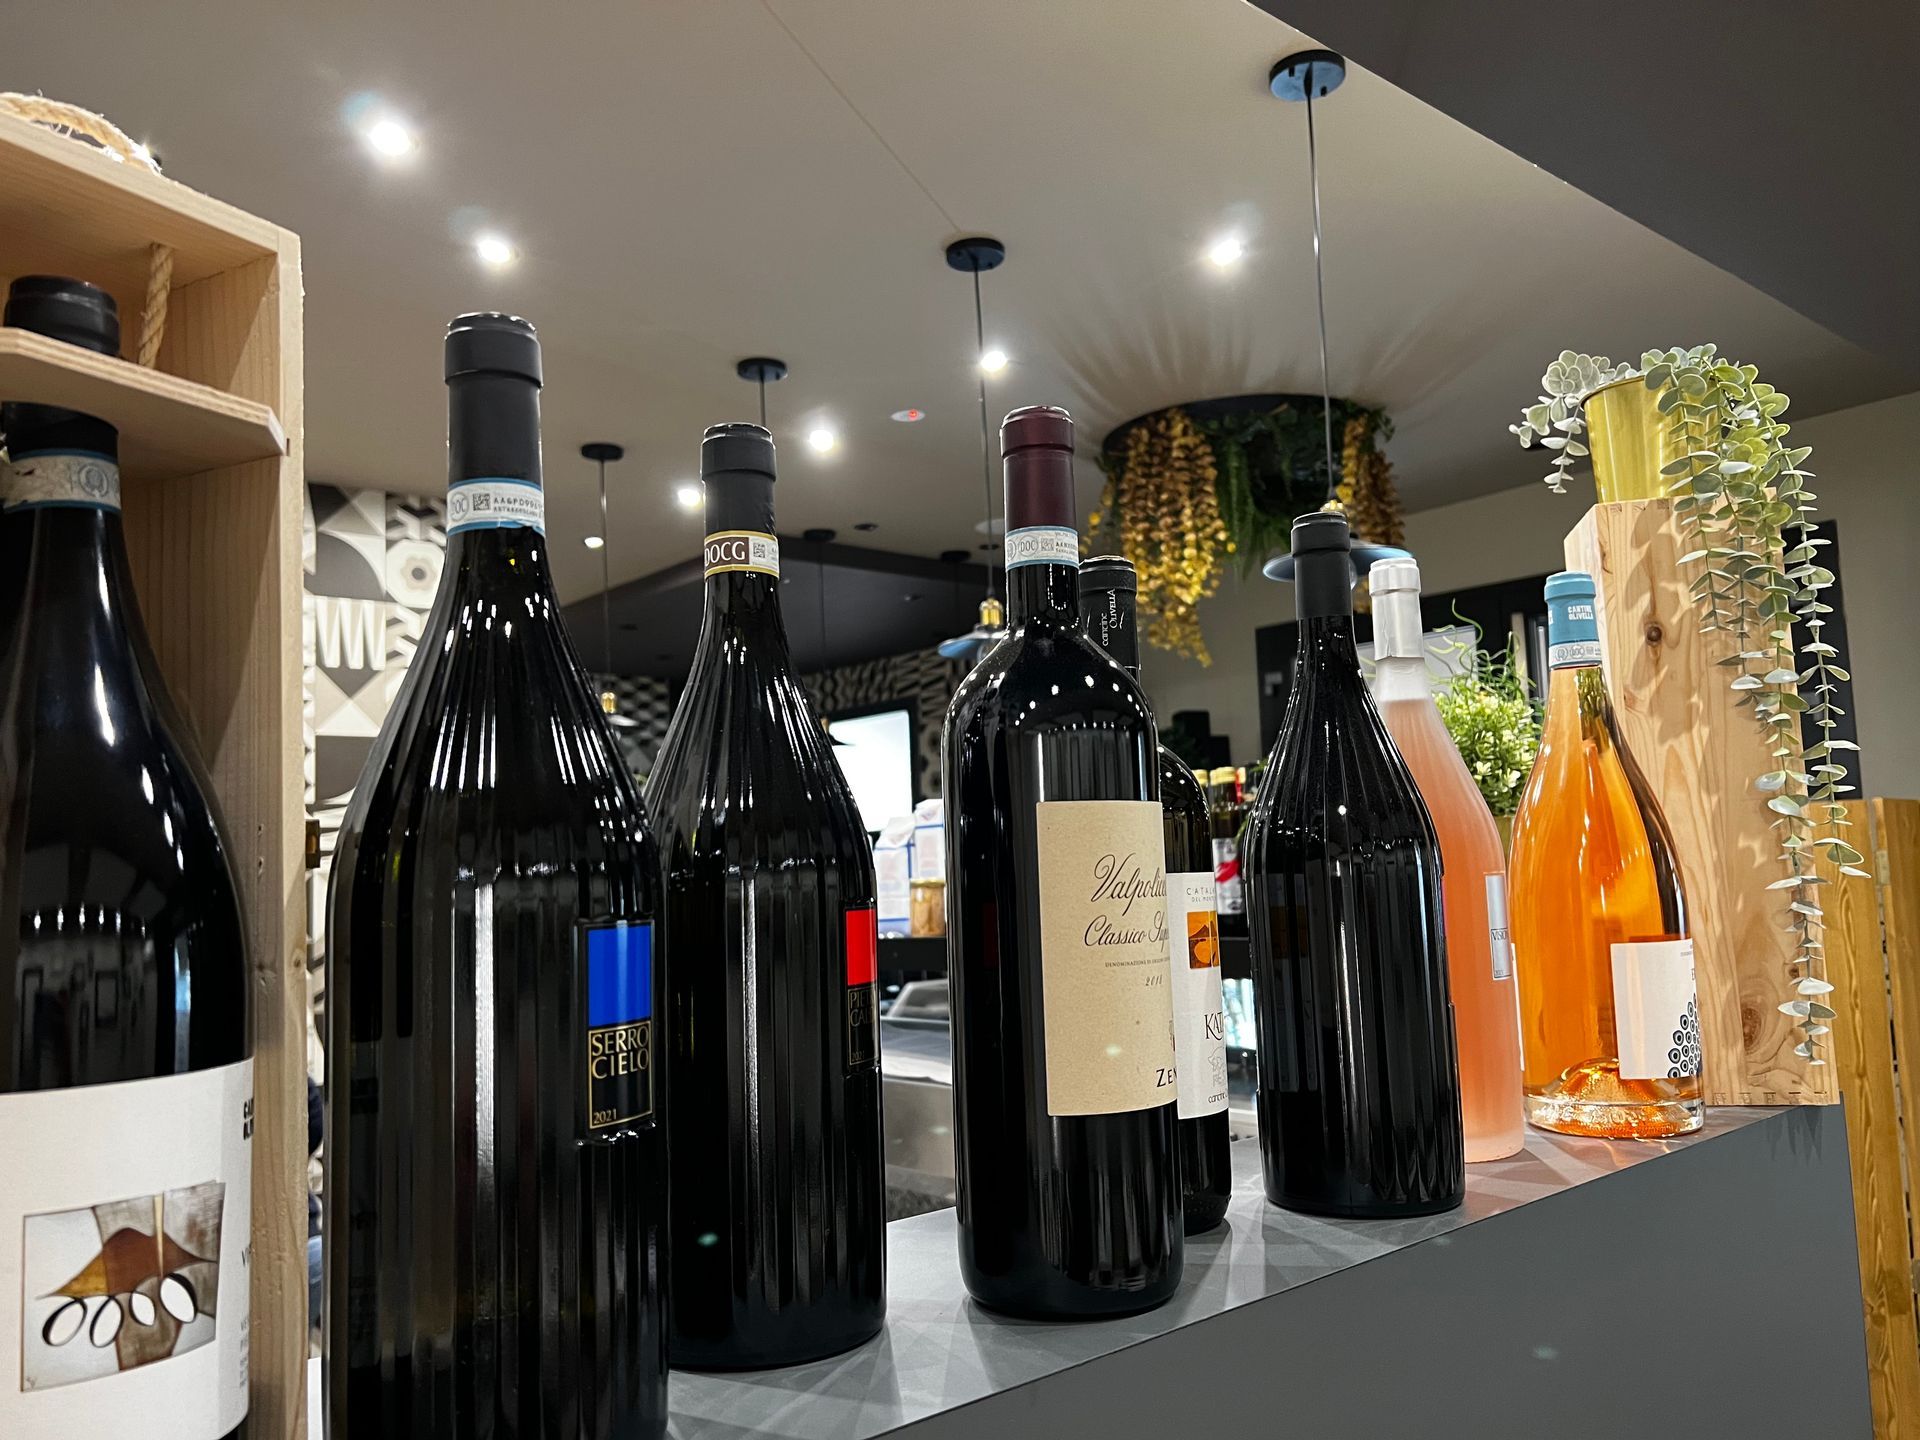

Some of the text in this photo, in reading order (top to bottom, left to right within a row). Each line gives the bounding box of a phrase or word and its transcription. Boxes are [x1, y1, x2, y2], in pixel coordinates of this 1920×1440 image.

[705, 540, 746, 567] DOCG
[1084, 915, 1147, 947] Classico
[592, 1025, 649, 1057] SERRO
[592, 1048, 649, 1079] CIELO
[593, 1108, 617, 1125] 2021
